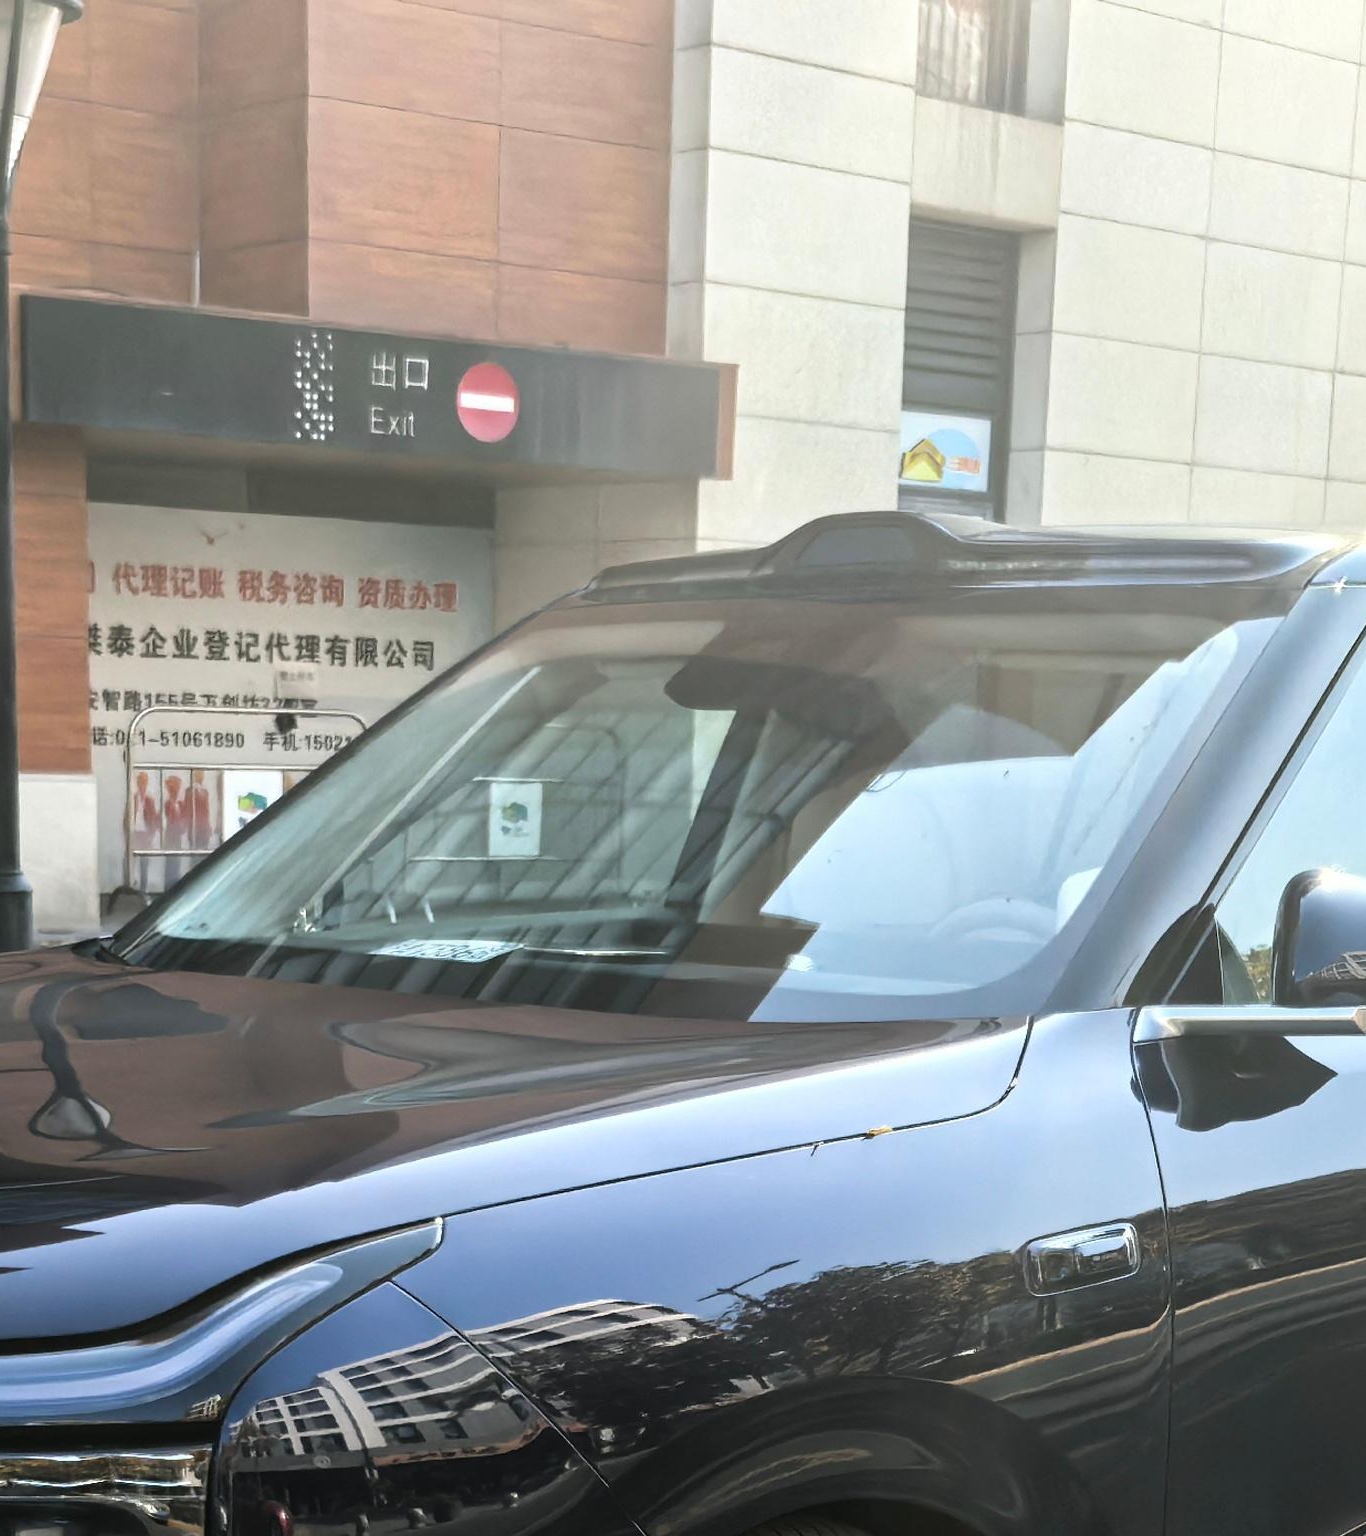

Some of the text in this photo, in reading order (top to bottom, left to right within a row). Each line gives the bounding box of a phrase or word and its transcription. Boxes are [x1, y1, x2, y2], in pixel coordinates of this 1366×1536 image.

[371, 351, 429, 390] 出口
[371, 406, 415, 437] Exit
[112, 562, 225, 599] 代理记账
[238, 569, 344, 607] 税务咨询
[357, 576, 457, 612] 资质办理
[92, 727, 245, 749] 话:01-51061890
